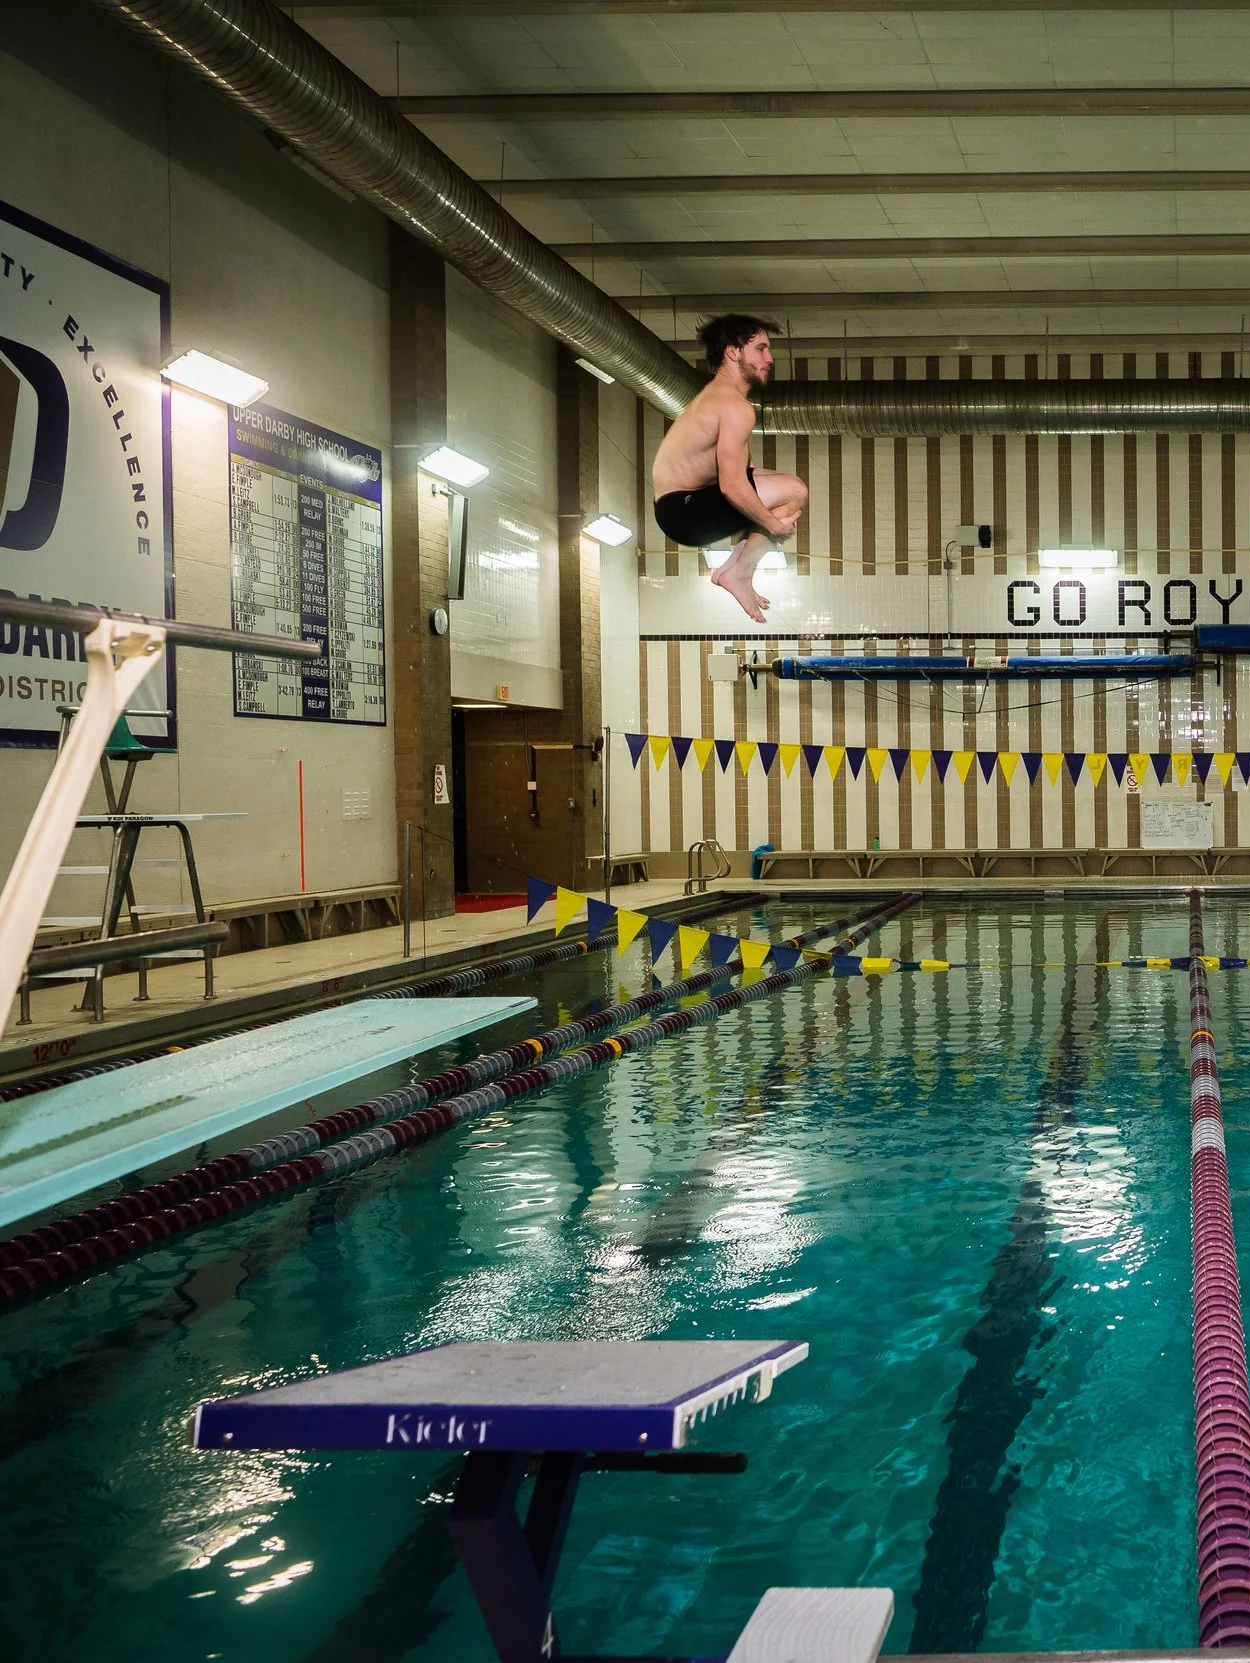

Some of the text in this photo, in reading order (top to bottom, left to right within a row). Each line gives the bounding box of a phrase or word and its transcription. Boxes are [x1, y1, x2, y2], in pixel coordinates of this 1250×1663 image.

[63, 314, 150, 555] EXCELLENCE
[233, 406, 263, 430] UPPER
[266, 416, 295, 441] DARBY
[297, 428, 316, 450] HIGH
[318, 436, 350, 463] SCHOOL
[236, 430, 279, 453] SWIMMING
[300, 473, 323, 489] EVENTS
[301, 494, 323, 509] 200 MED
[303, 508, 321, 521] RELAY
[301, 526, 310, 537] 200
[311, 529, 325, 541] FREE
[305, 539, 315, 548] 200
[302, 549, 309, 558] 50
[310, 551, 324, 562] FREE
[307, 561, 324, 573] DIVES
[302, 571, 308, 580] 11
[309, 572, 325, 584] DIVES
[304, 583, 324, 594] 100 FLY
[302, 592, 326, 605] 100 FREE
[1008, 581, 1086, 627] GO
[302, 603, 311, 613] 500
[312, 605, 326, 616] FREE
[0, 589, 121, 667] DAR
[302, 623, 327, 636] 200 FREE
[313, 657, 328, 667] BACK
[302, 667, 328, 677] 100 BREAST
[0, 676, 87, 702] ISTRIC
[304, 686, 328, 697] 400 FREE
[307, 699, 326, 709] RELAY
[541, 1611, 555, 1660] 4
